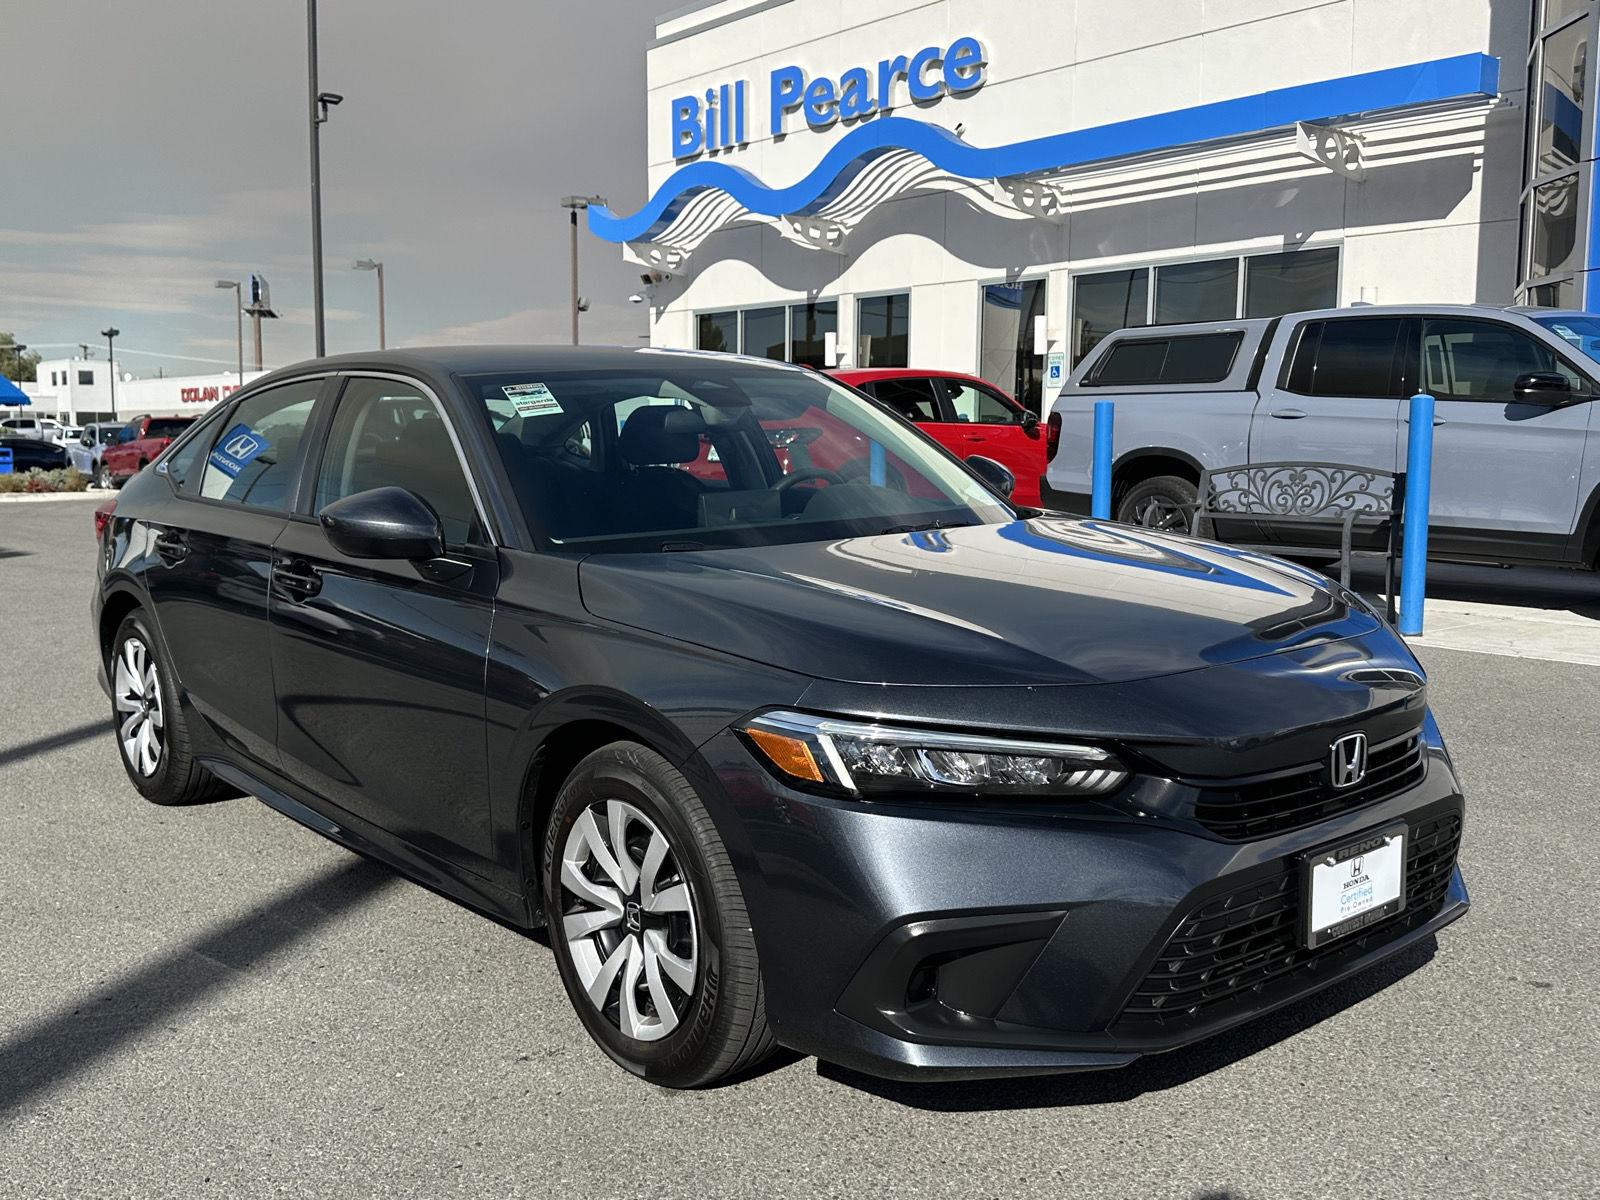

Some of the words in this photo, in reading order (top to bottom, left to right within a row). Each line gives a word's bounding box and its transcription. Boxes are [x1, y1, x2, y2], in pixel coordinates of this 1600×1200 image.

[671, 79, 749, 159] Bill
[770, 36, 988, 136] Pearce
[181, 386, 219, 402] DOLAN
[1343, 874, 1370, 890] HONDA
[1341, 884, 1373, 905] Certified
